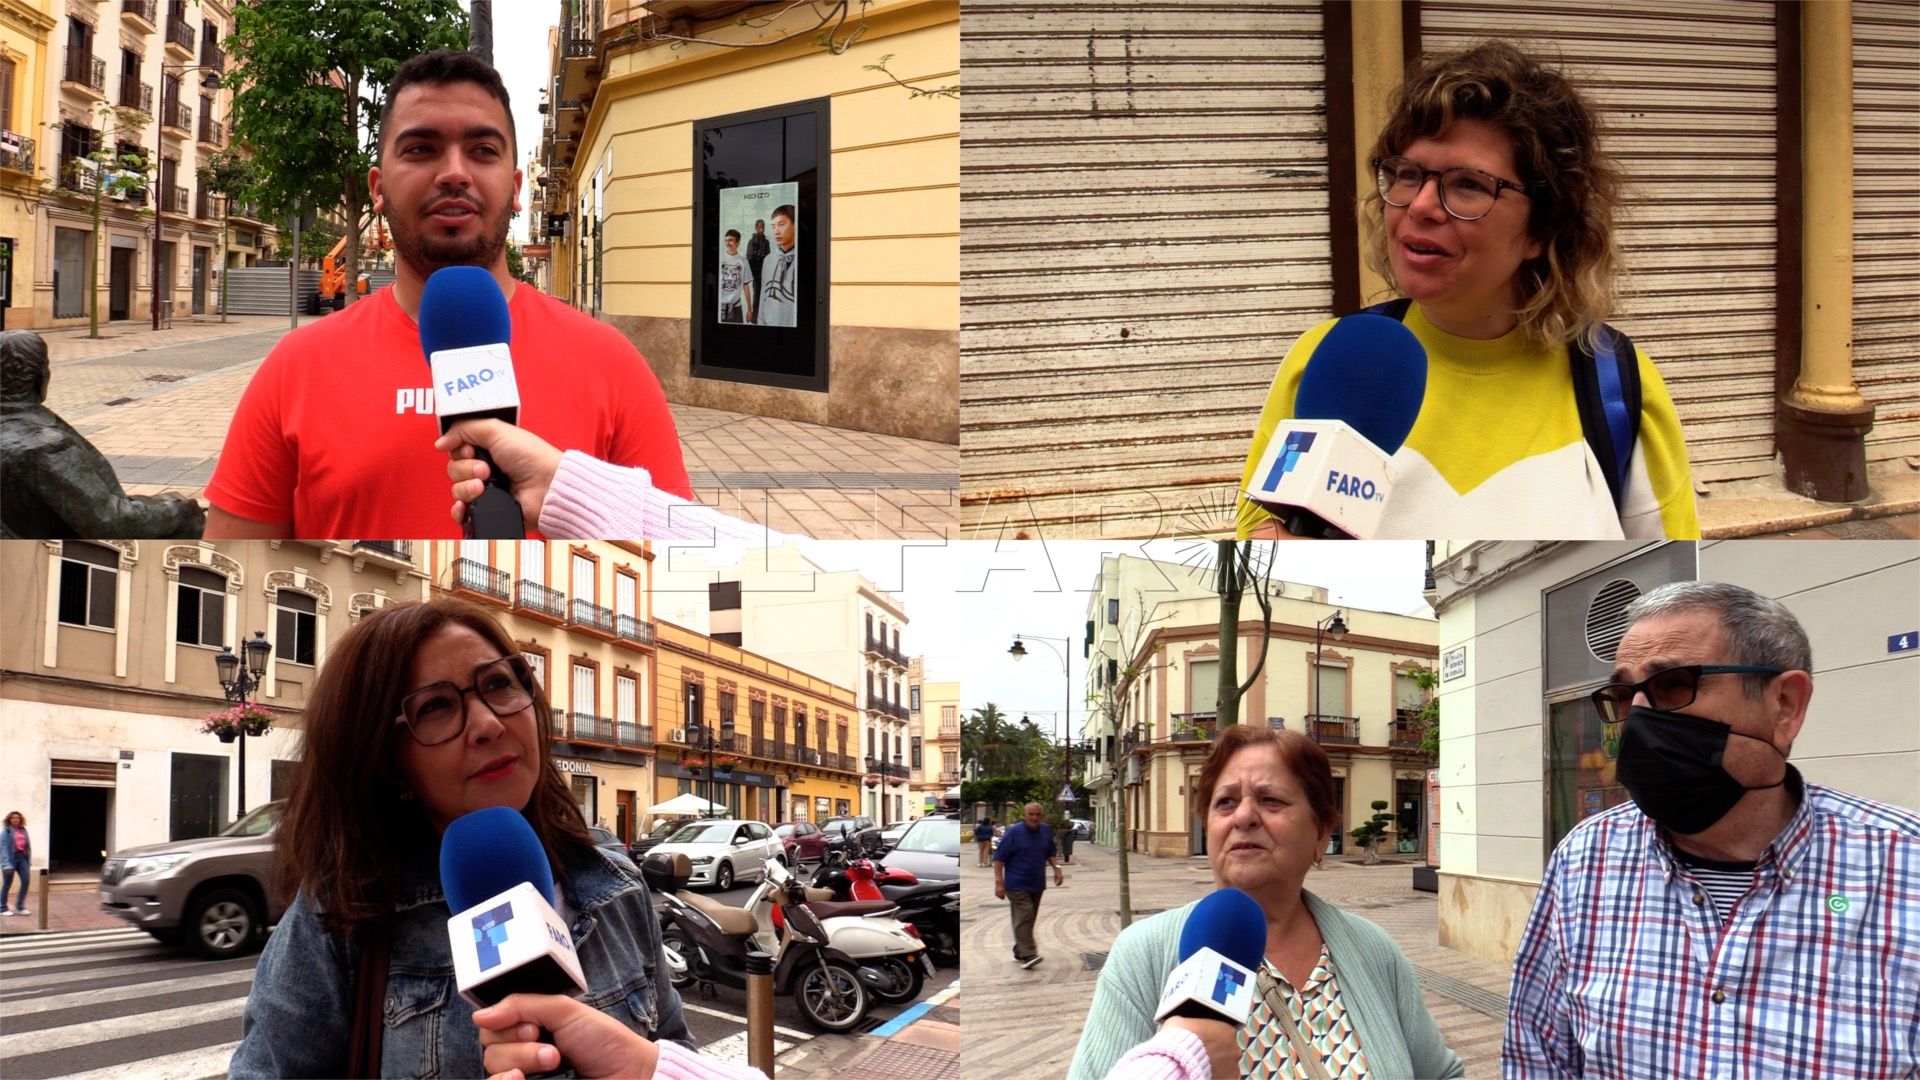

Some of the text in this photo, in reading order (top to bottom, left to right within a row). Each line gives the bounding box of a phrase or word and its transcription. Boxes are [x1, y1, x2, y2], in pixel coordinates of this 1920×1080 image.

[744, 192, 770, 200] KENZO
[444, 368, 494, 396] FARO
[396, 387, 434, 415] PU
[1326, 470, 1376, 500] FARO
[1898, 635, 1909, 649] 4
[552, 759, 592, 774] EDONIA
